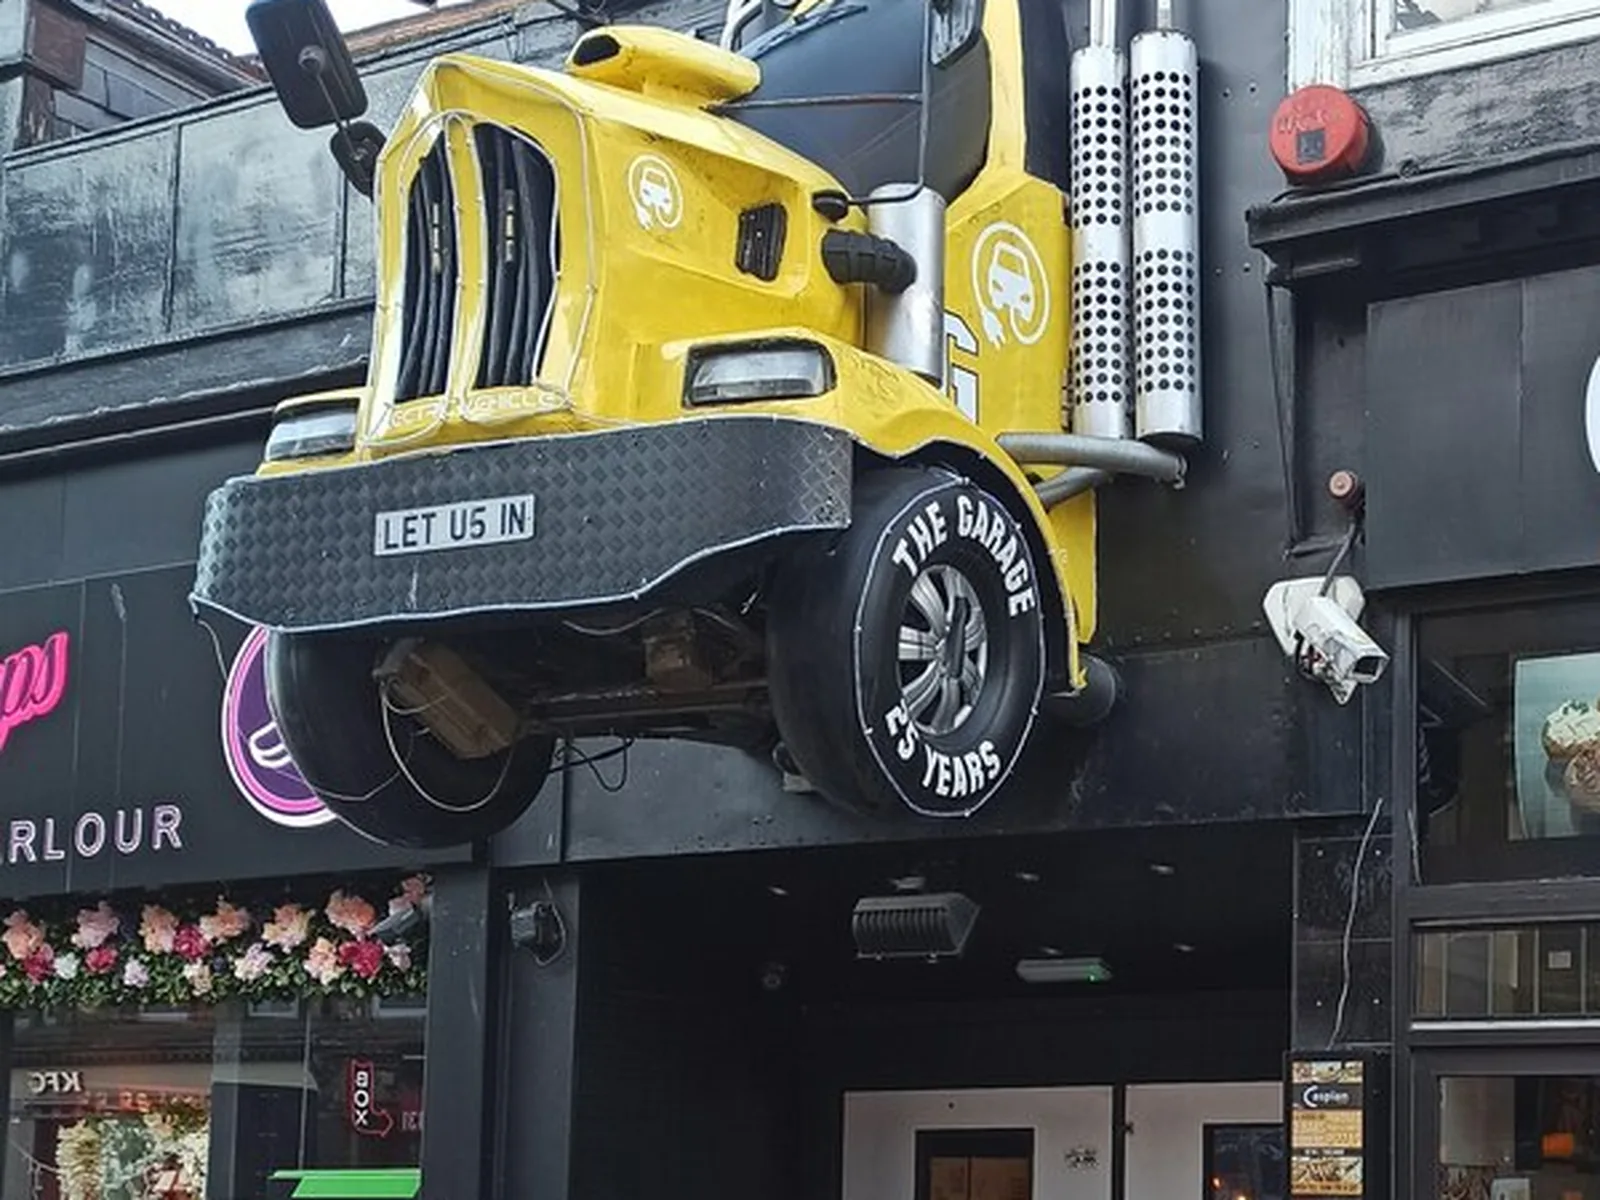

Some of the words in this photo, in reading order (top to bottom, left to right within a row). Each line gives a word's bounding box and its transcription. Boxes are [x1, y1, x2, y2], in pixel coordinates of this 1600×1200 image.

[384, 512, 437, 549] LET
[500, 501, 527, 536] IN
[892, 501, 948, 577] THE
[956, 495, 1036, 617] GARAGE
[922, 740, 1001, 798] YEARS
[0, 804, 183, 864] RLOUR
